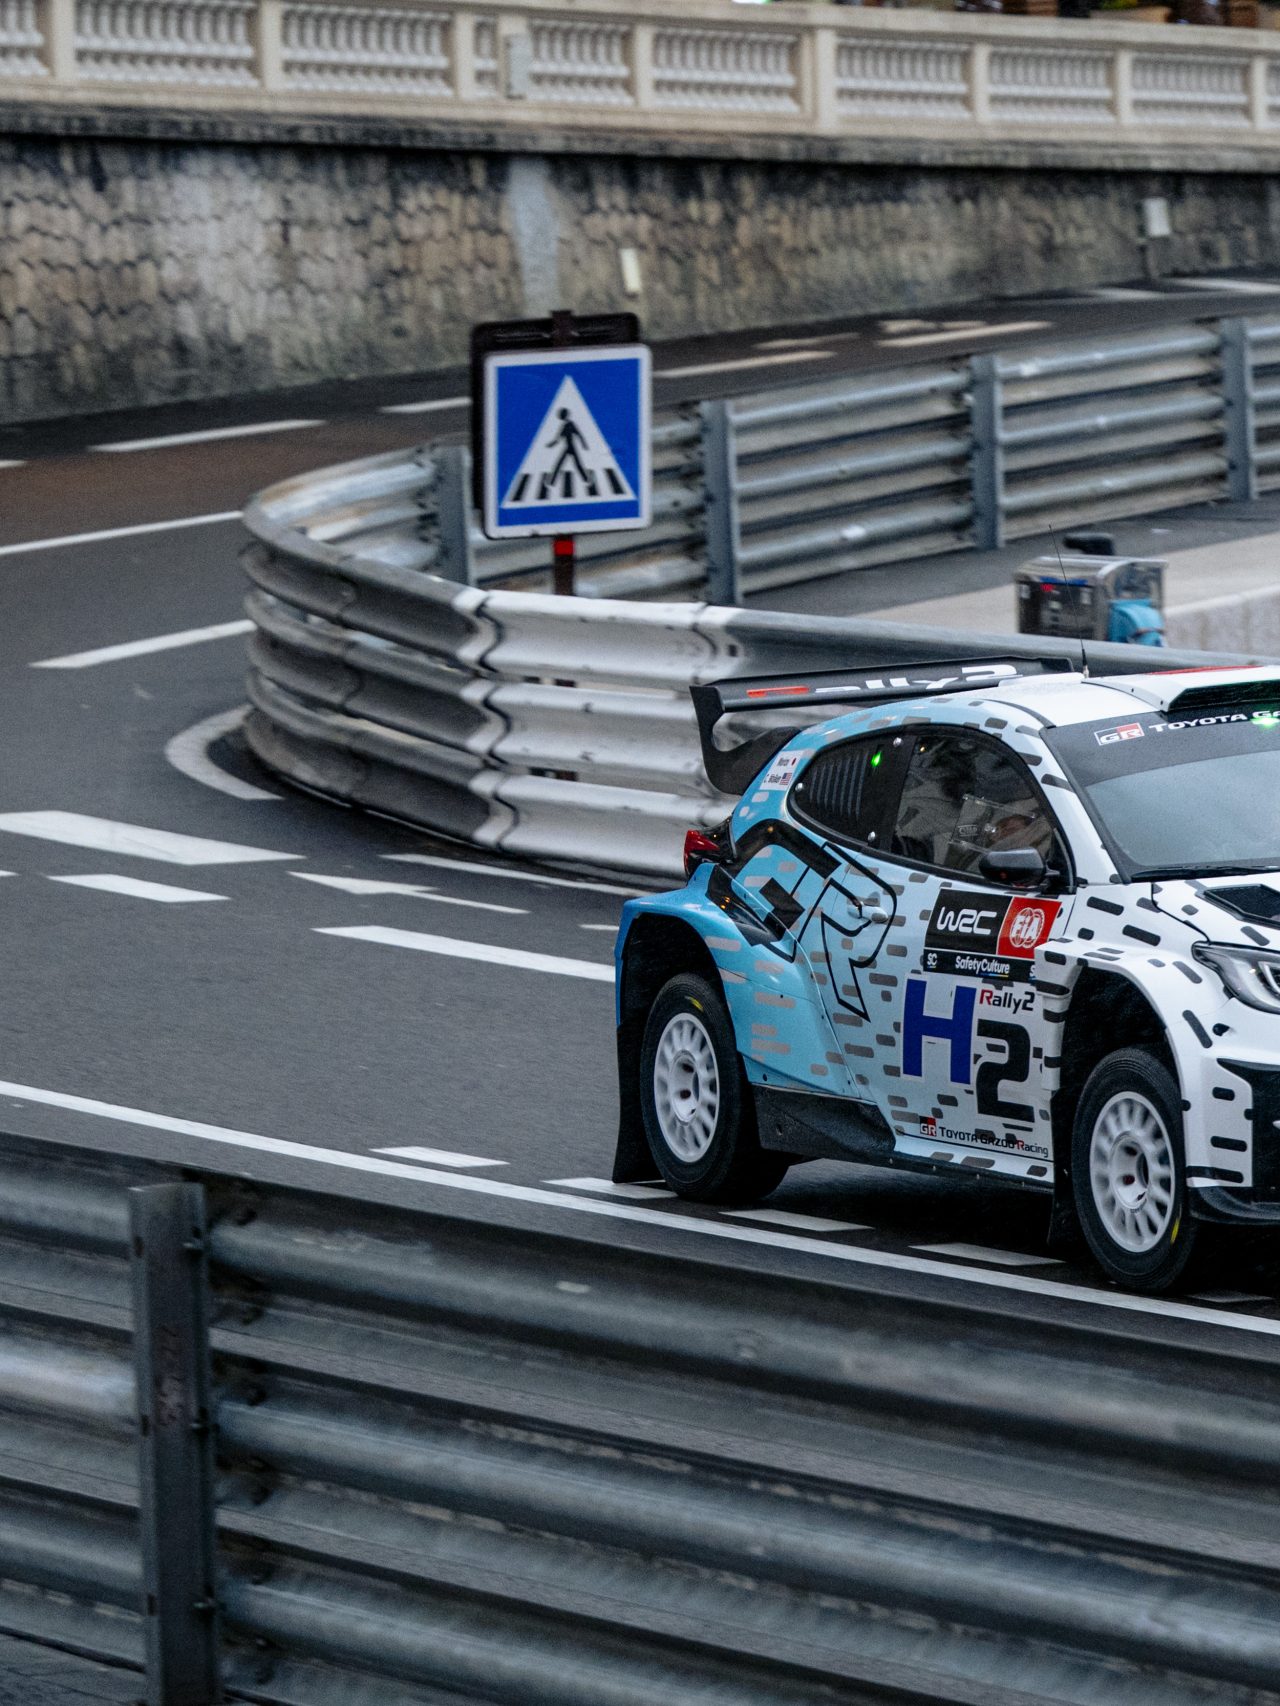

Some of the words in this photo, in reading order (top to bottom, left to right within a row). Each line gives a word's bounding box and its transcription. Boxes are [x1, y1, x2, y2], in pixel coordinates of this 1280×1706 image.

[1097, 725, 1144, 745] GR
[1149, 713, 1248, 733] TOYOTA
[936, 906, 998, 935] WRC
[955, 955, 1011, 975] SafetyCulture
[979, 988, 1035, 1014] Rally2
[902, 978, 1035, 1123] H2
[920, 1123, 937, 1137] GR
[939, 1126, 978, 1143] TOYOTA
[1015, 1140, 1049, 1158] Racing
